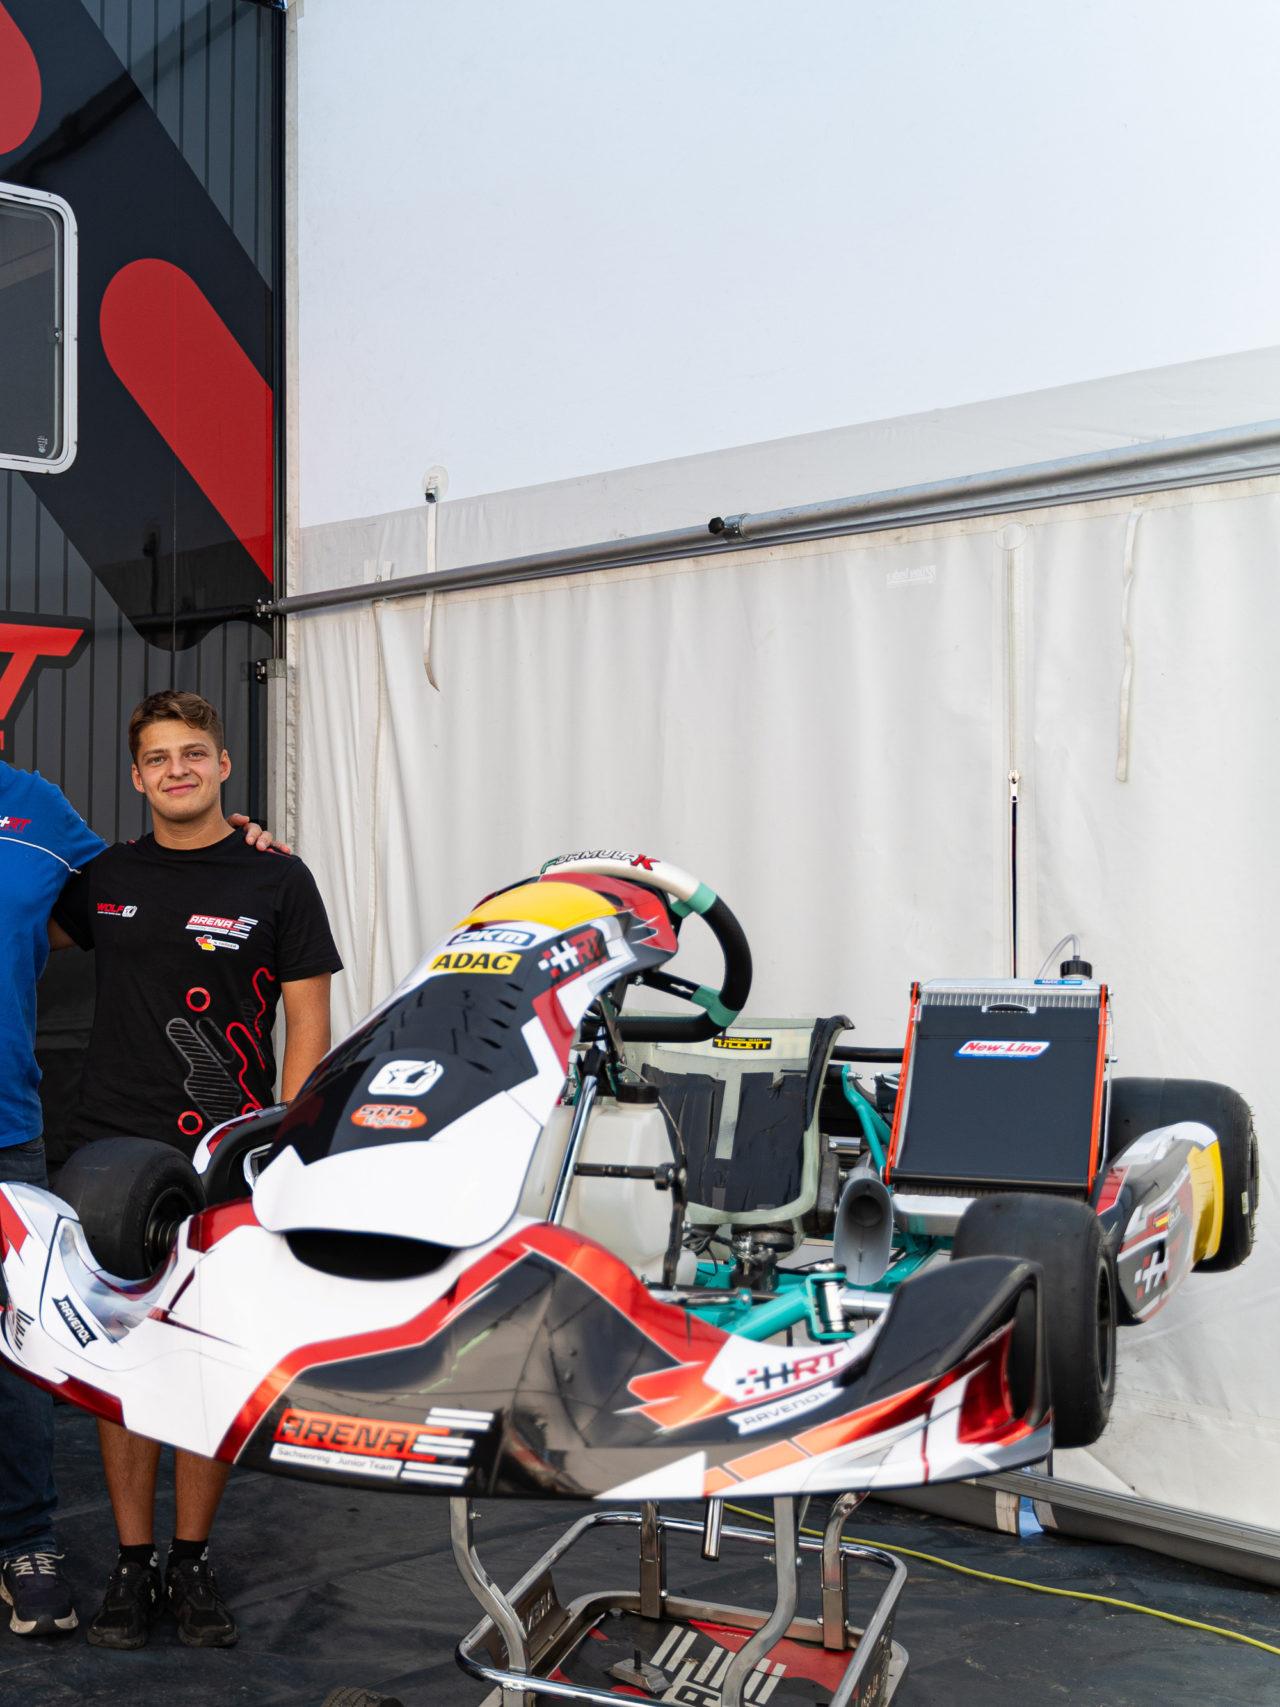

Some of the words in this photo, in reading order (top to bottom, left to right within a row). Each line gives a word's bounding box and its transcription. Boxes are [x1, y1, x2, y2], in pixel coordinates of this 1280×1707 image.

[96, 902, 125, 913] WOLF
[189, 915, 235, 929] ARENA
[431, 952, 514, 971] ADAC
[57, 1300, 90, 1344] RAVENOL
[753, 1347, 844, 1390] HRT
[743, 1391, 832, 1425] RAVENOL
[281, 1415, 409, 1452] ARENA
[277, 1446, 330, 1464] Sachsenring
[338, 1454, 366, 1468] Junior
[368, 1460, 395, 1472] Team
